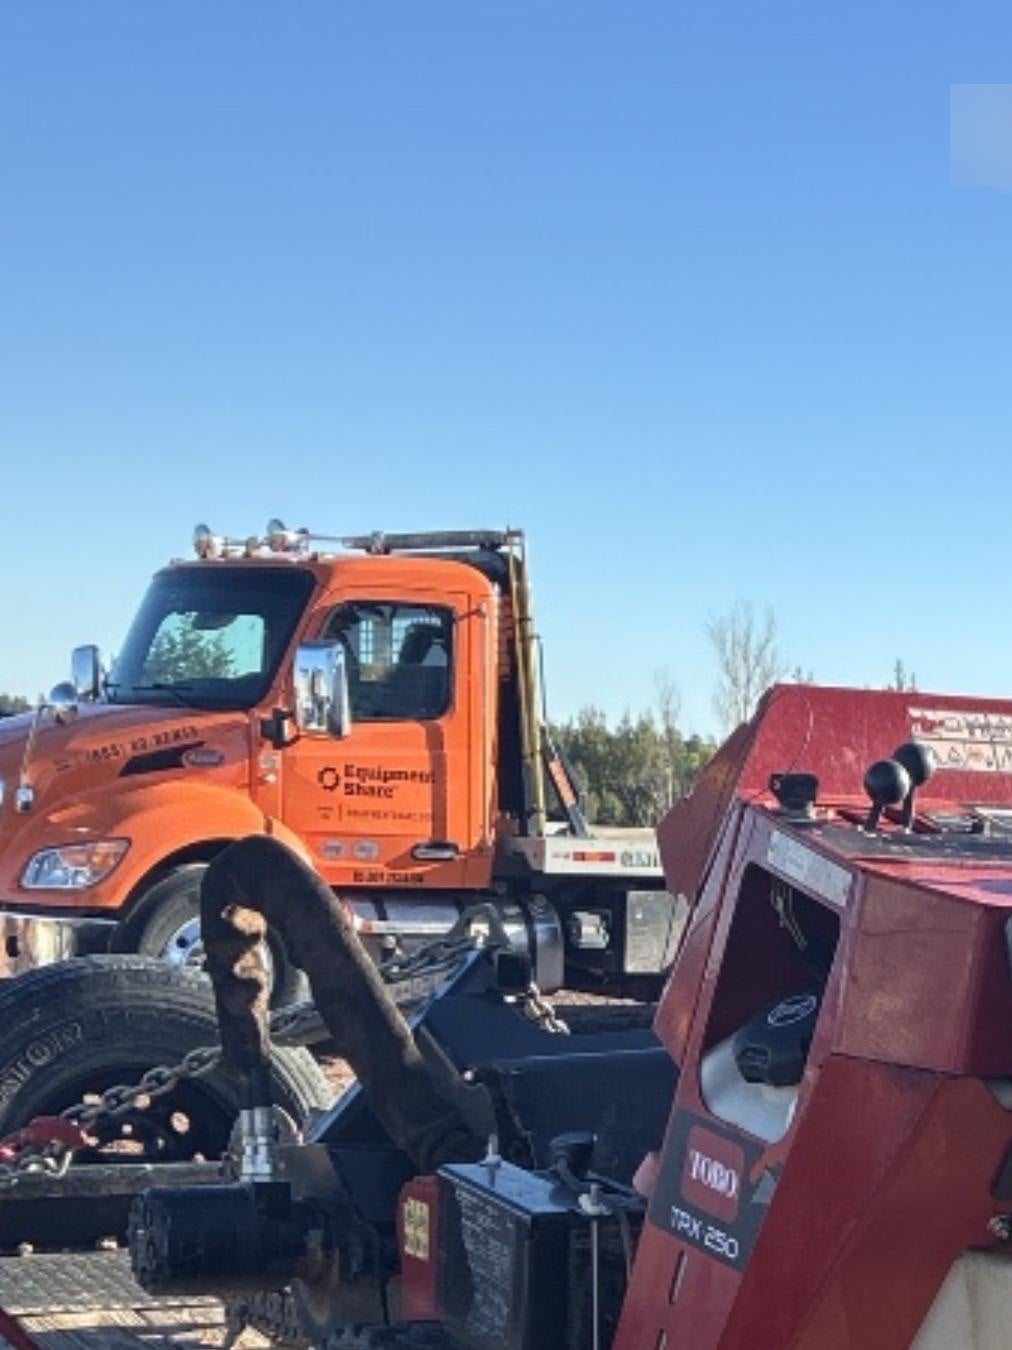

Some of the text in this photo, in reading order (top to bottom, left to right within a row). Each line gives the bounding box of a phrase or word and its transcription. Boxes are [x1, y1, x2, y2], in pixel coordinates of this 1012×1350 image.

[344, 764, 436, 784] Equipment
[344, 783, 393, 798] Share
[690, 1151, 739, 1198] TORO
[671, 1205, 739, 1260] TRX 250
